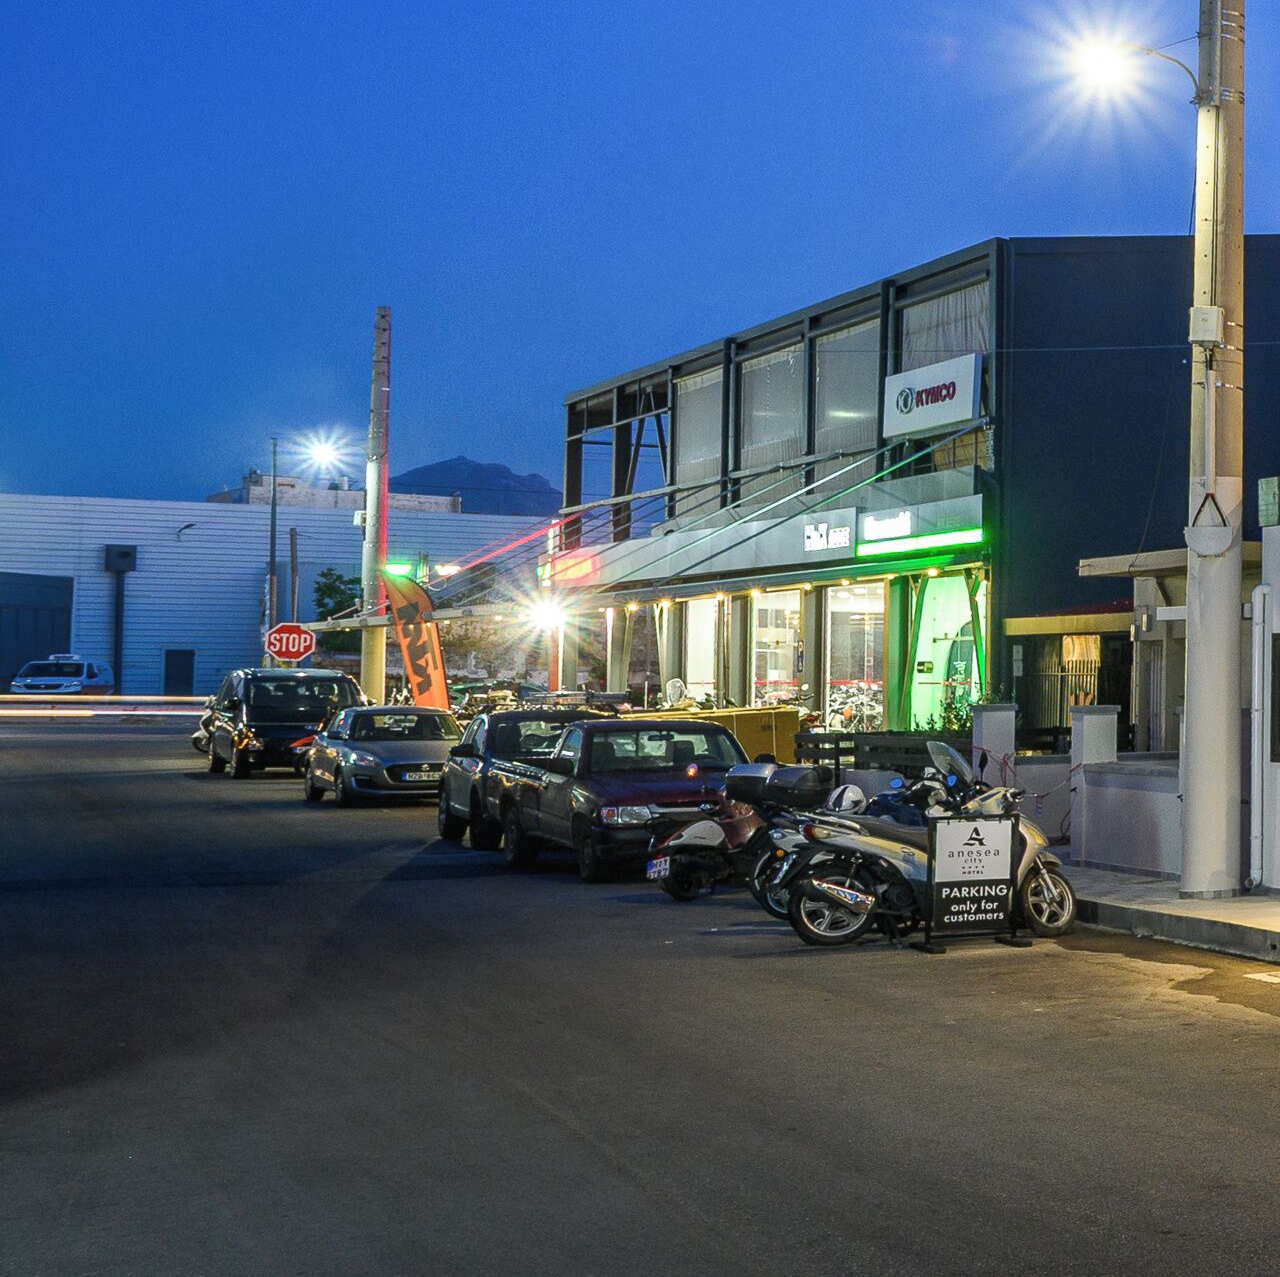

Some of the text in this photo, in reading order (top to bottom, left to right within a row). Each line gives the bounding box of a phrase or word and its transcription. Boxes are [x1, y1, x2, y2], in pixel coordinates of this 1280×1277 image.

[915, 381, 956, 408] KYMCO
[270, 633, 311, 652] STOP
[947, 849, 1000, 858] anesea
[942, 885, 1008, 898] PARKING
[951, 900, 998, 913] only for
[944, 912, 1004, 922] customers
